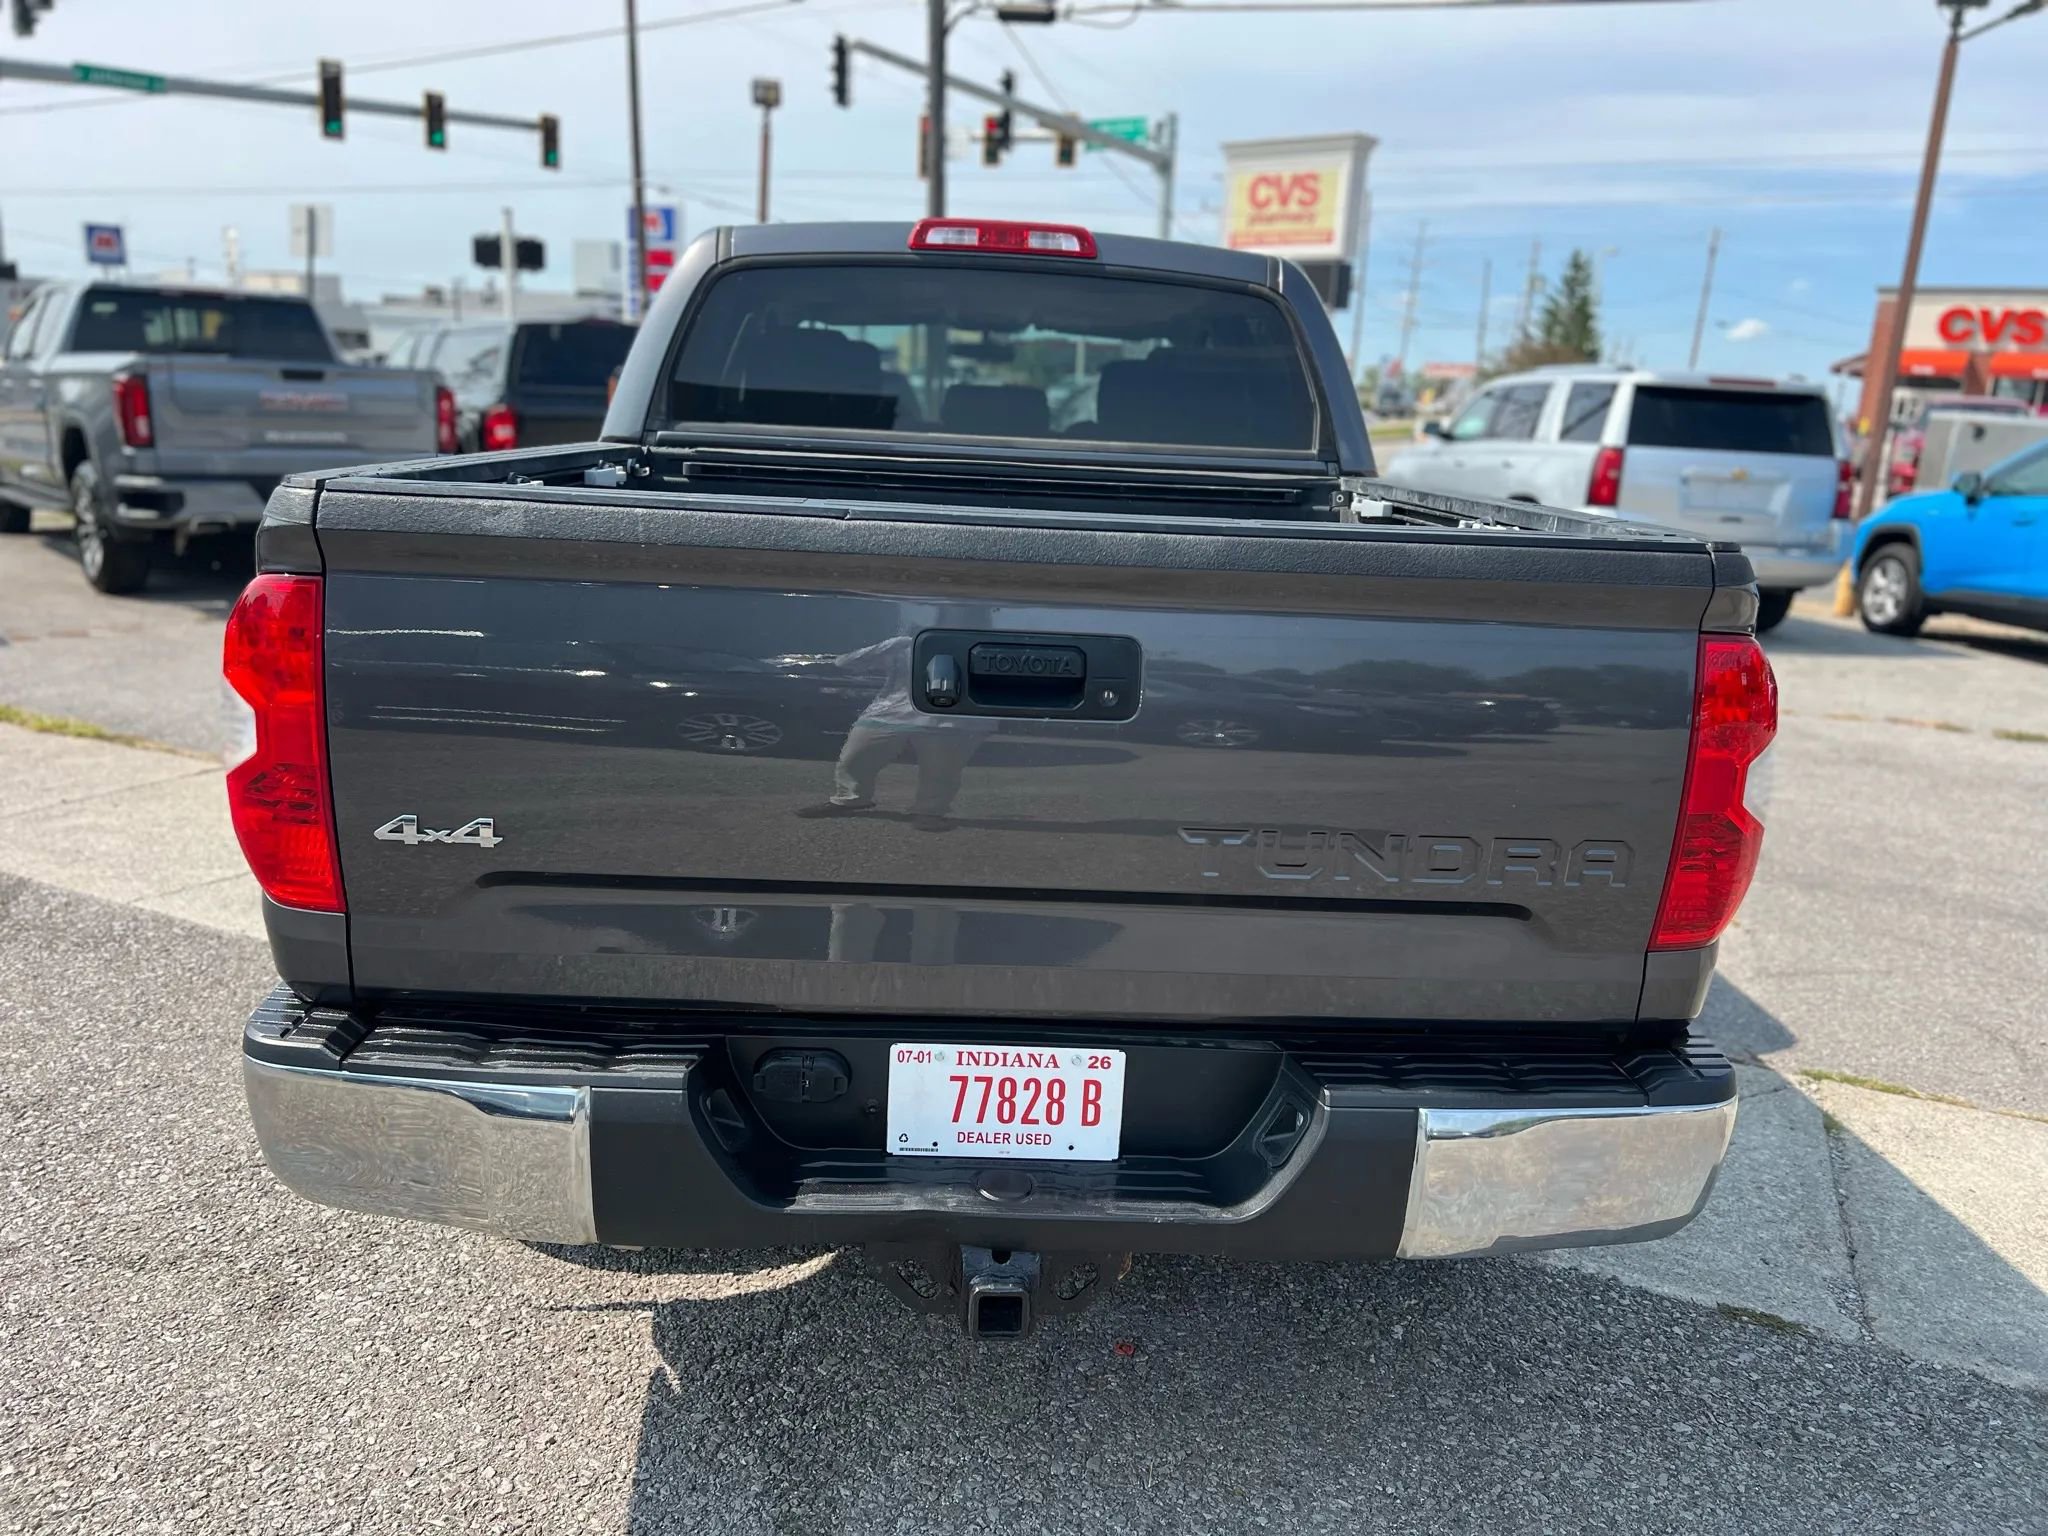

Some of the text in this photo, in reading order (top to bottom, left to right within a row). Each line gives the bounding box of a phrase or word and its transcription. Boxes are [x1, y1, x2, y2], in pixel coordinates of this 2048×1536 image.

[1248, 171, 1320, 209] CVS
[1938, 307, 2046, 346] CVS
[981, 655, 1076, 676] TOYOTA
[373, 814, 504, 848] 4x4
[1176, 826, 1636, 888] TUNDRA
[897, 1050, 932, 1064] 07-01
[955, 1050, 1060, 1069] INDIANA
[1087, 1055, 1112, 1070] 26
[949, 1075, 1102, 1127] 77828 B
[956, 1131, 1052, 1146] DEALER USED
